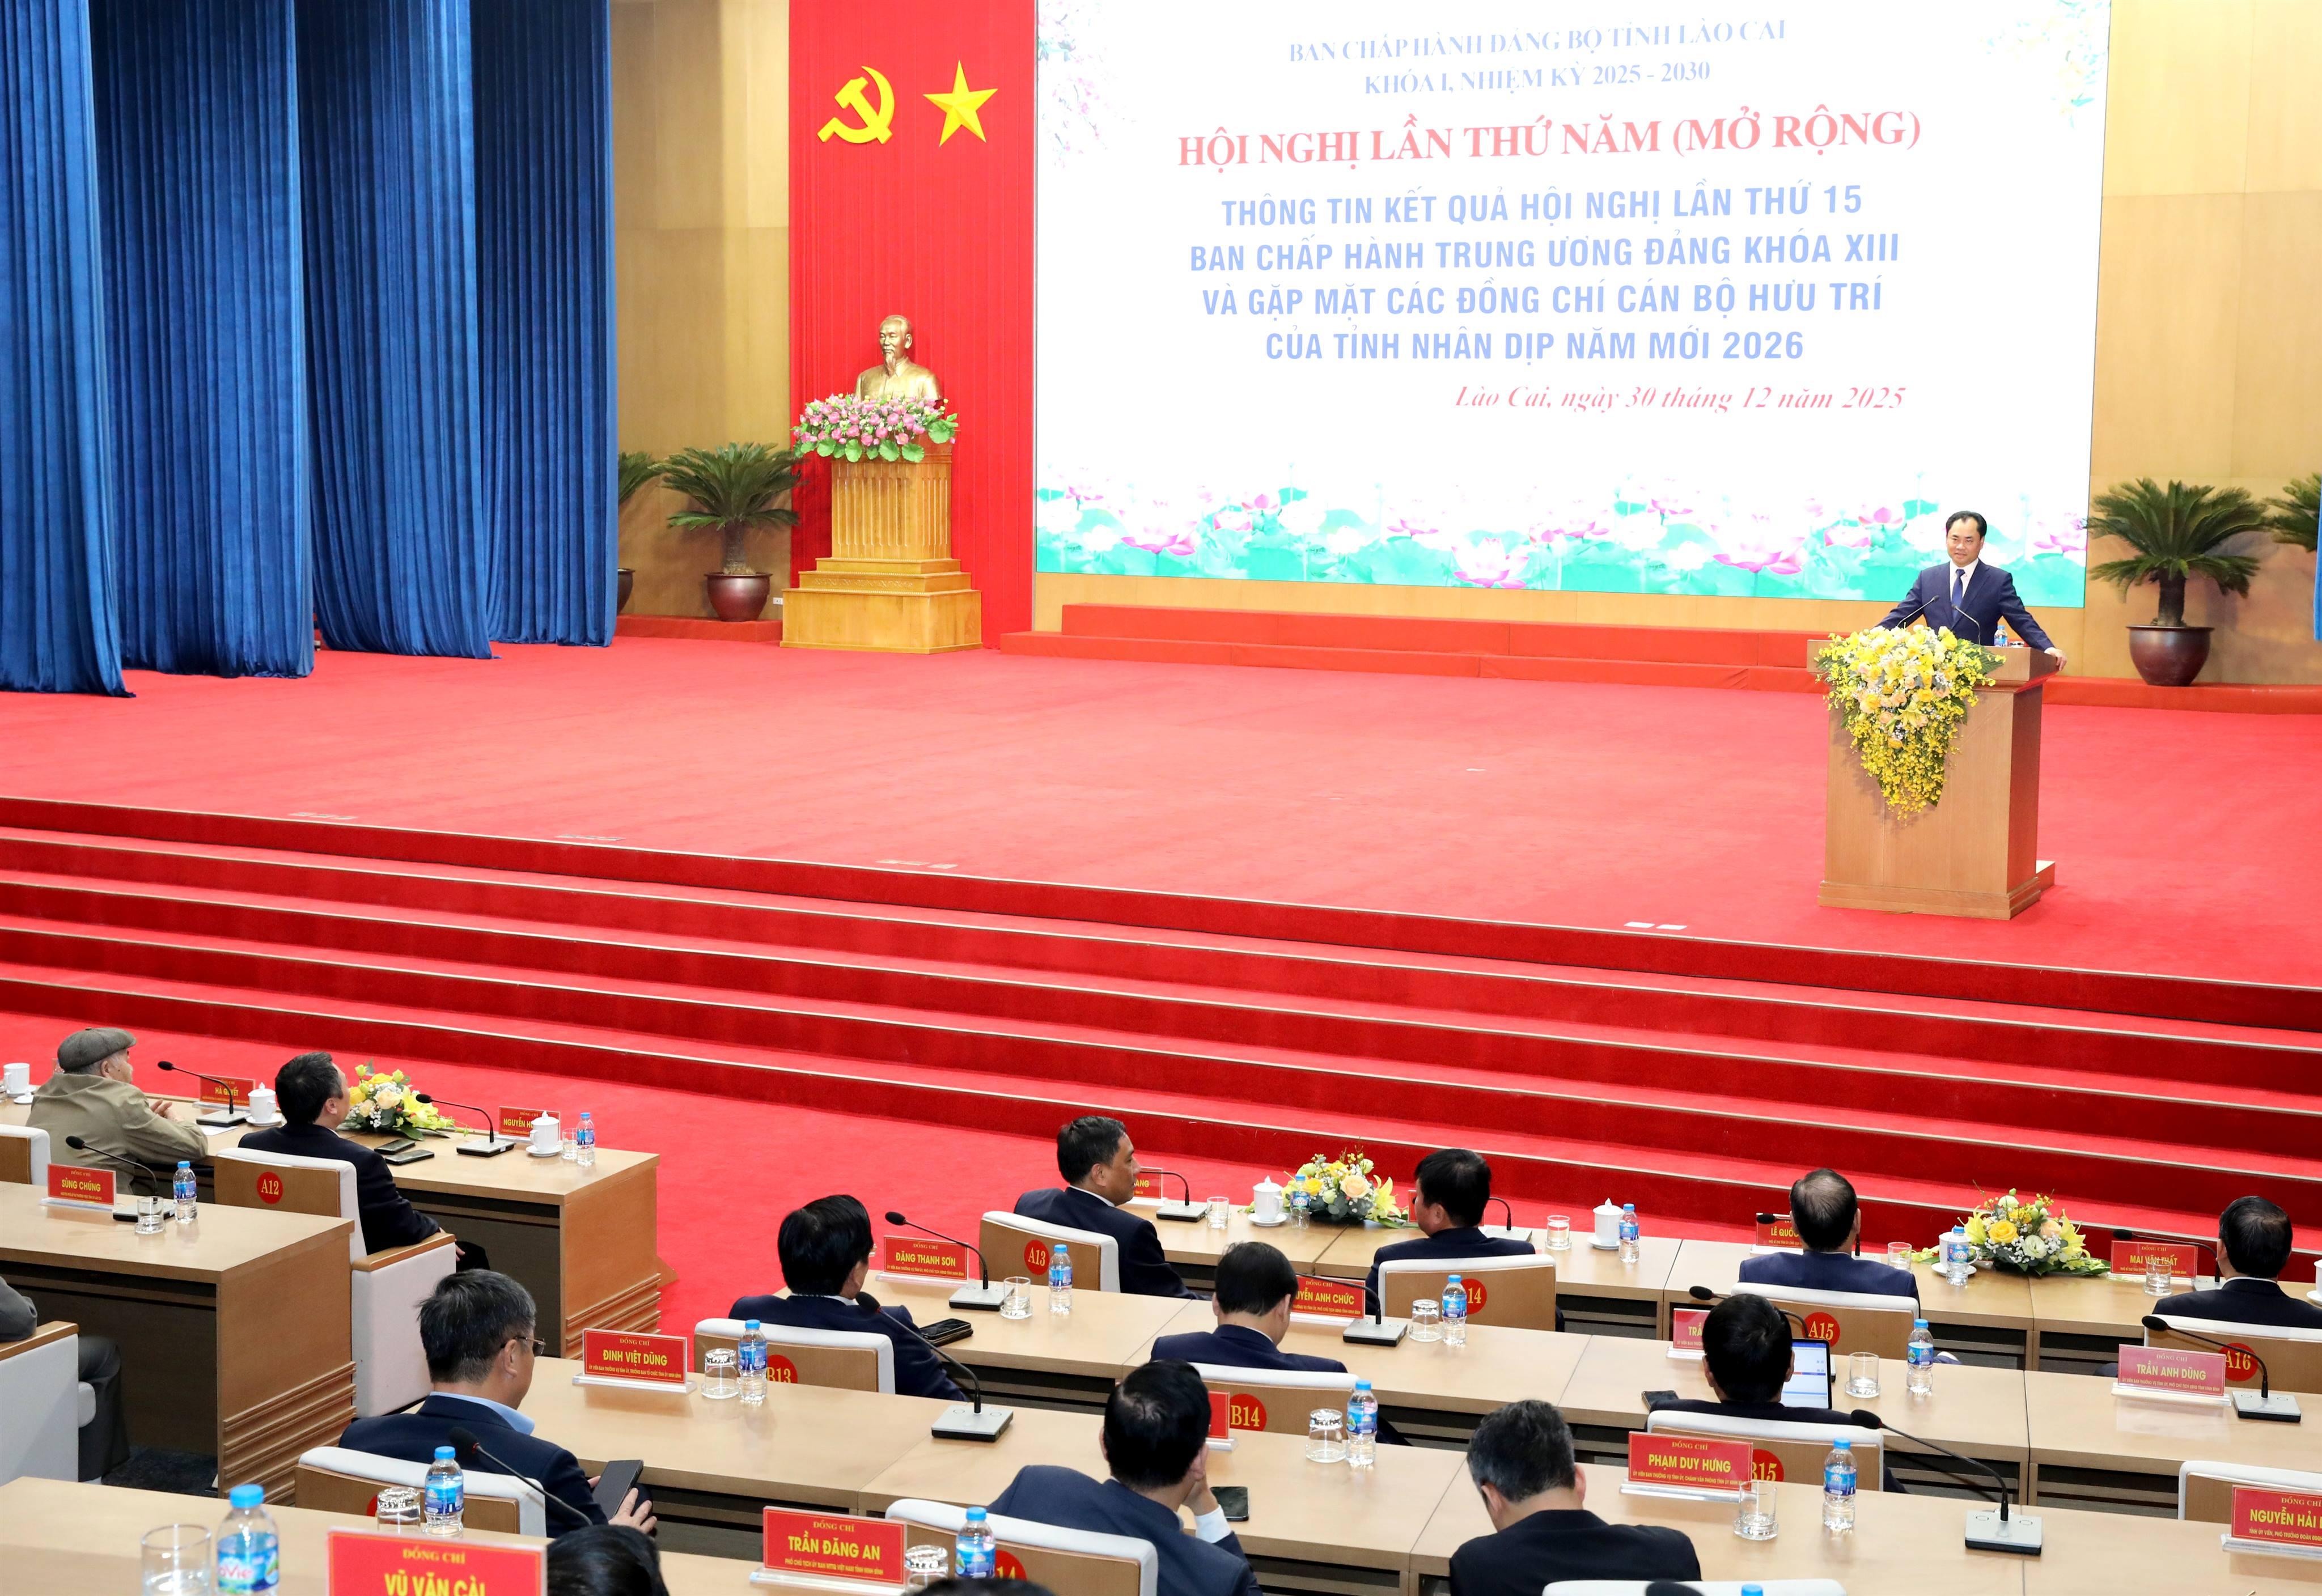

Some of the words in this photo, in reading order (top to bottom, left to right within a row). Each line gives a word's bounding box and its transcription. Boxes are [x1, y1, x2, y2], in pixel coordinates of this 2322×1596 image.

[1290, 43, 1335, 62] BAN
[1414, 31, 1481, 56] HÀNH
[1568, 26, 1602, 53] BỘ
[1679, 18, 1732, 45] LÀO
[1740, 20, 1785, 40] CAI
[1366, 69, 1434, 94] KHÓA
[1442, 73, 1454, 91] I,
[1461, 69, 1542, 94] NHIỆM
[1552, 61, 1586, 86] KỲ
[1593, 65, 1641, 84] 2025
[1661, 61, 1710, 82] 2030
[1179, 126, 1249, 173] HỘI
[1259, 131, 1361, 170] NGHỊ
[1370, 109, 1453, 162] LẦN
[1464, 114, 1554, 158] THỨ
[1561, 111, 1662, 154] NĂM
[1673, 105, 1760, 157] (MỞ
[1772, 104, 1921, 156] RỘNG)
[1221, 193, 1315, 227] THÔNG
[1327, 195, 1372, 227] TIN
[1385, 187, 1437, 226] KẾT
[1448, 186, 1509, 226] QUẢ
[1521, 185, 1572, 227] HỘI
[1586, 190, 1659, 224] NGHỊ
[1671, 178, 1731, 218] LẦN
[1744, 179, 1811, 218] THỨ
[1824, 184, 1861, 215] 15
[1188, 245, 1246, 272] BAN
[1257, 234, 1333, 272] CHẤP
[1344, 236, 1423, 272] HÀNH
[1436, 239, 1535, 269] TRUNG
[1549, 236, 1632, 269] ƯƠNG
[1643, 230, 1731, 266] ĐẢNG
[1744, 228, 1832, 264] KHÓA
[1844, 233, 1899, 262] XIII
[1202, 283, 1238, 315] VÀ
[1249, 283, 1303, 321] GẶP
[1315, 283, 1376, 321] MẶT
[1387, 281, 1446, 315] CÁC
[1456, 277, 1540, 317] ĐỒNG
[1551, 278, 1605, 314] CHÍ
[1618, 278, 1679, 315] CÁN
[1693, 274, 1735, 319] BỘ
[1749, 280, 1815, 313] HƯU
[1829, 275, 1882, 311] TRÍ
[1266, 325, 1323, 360] CỦA
[1333, 325, 1400, 360] TỈNH
[1412, 326, 1491, 360] NHÂN
[1505, 332, 1554, 366] DỊP
[1566, 327, 1636, 360] NĂM
[1648, 326, 1710, 360] MỚI
[1723, 331, 1804, 361] 2026
[1454, 386, 1500, 408] Lào
[1508, 385, 1552, 410] Cai,
[1560, 386, 1620, 415] ngày
[1626, 386, 1657, 409] 30
[1662, 387, 1732, 413] tháng
[1742, 386, 1772, 409] 12
[1778, 388, 1833, 408] năm
[1841, 384, 1906, 409] 2025
[503, 1117, 526, 1127] NGUYỄN
[61, 1177, 78, 1190] SÙNG
[79, 1181, 101, 1192] CHÚNG
[261, 1179, 279, 1195] A12
[896, 1250, 916, 1264] ĐẶNG
[917, 1254, 940, 1266] THANH
[942, 1255, 956, 1267] SƠN
[1028, 1247, 1046, 1266] A13
[2130, 1255, 2143, 1264] MAI
[1296, 1287, 1313, 1301] UYỄN
[1315, 1292, 1331, 1302] ANH
[1333, 1293, 1354, 1305] CHỨC
[1468, 1287, 1482, 1304] 14
[1808, 1321, 1834, 1340] A15
[603, 1349, 623, 1362] ĐINH
[625, 1349, 642, 1366] VIỆT
[643, 1351, 668, 1366] DŨNG
[2226, 1350, 2251, 1370] A16
[767, 1366, 791, 1383] B13
[2161, 1366, 2179, 1378] ANH
[2181, 1366, 2207, 1381] DŨNG
[1230, 1405, 1260, 1427] B14
[1672, 1440, 1693, 1449] ĐỒNG
[1649, 1454, 1677, 1470] PHẠM
[1680, 1457, 1700, 1470] DUY
[1702, 1458, 1731, 1473] HƯNG
[2281, 1496, 2304, 1505] ĐỒNG
[813, 1519, 837, 1530] ĐỒNG
[839, 1523, 855, 1533] CHÍ
[2250, 1506, 2294, 1526] NGUYỄN
[2297, 1510, 2316, 1528] HẢI
[788, 1530, 819, 1553] TRẦN
[822, 1538, 859, 1559] ĐĂNG
[862, 1544, 880, 1560] AN
[402, 1546, 440, 1561] ĐỒNG
[442, 1550, 465, 1564] CHÍ
[384, 1569, 409, 1596] VŨ
